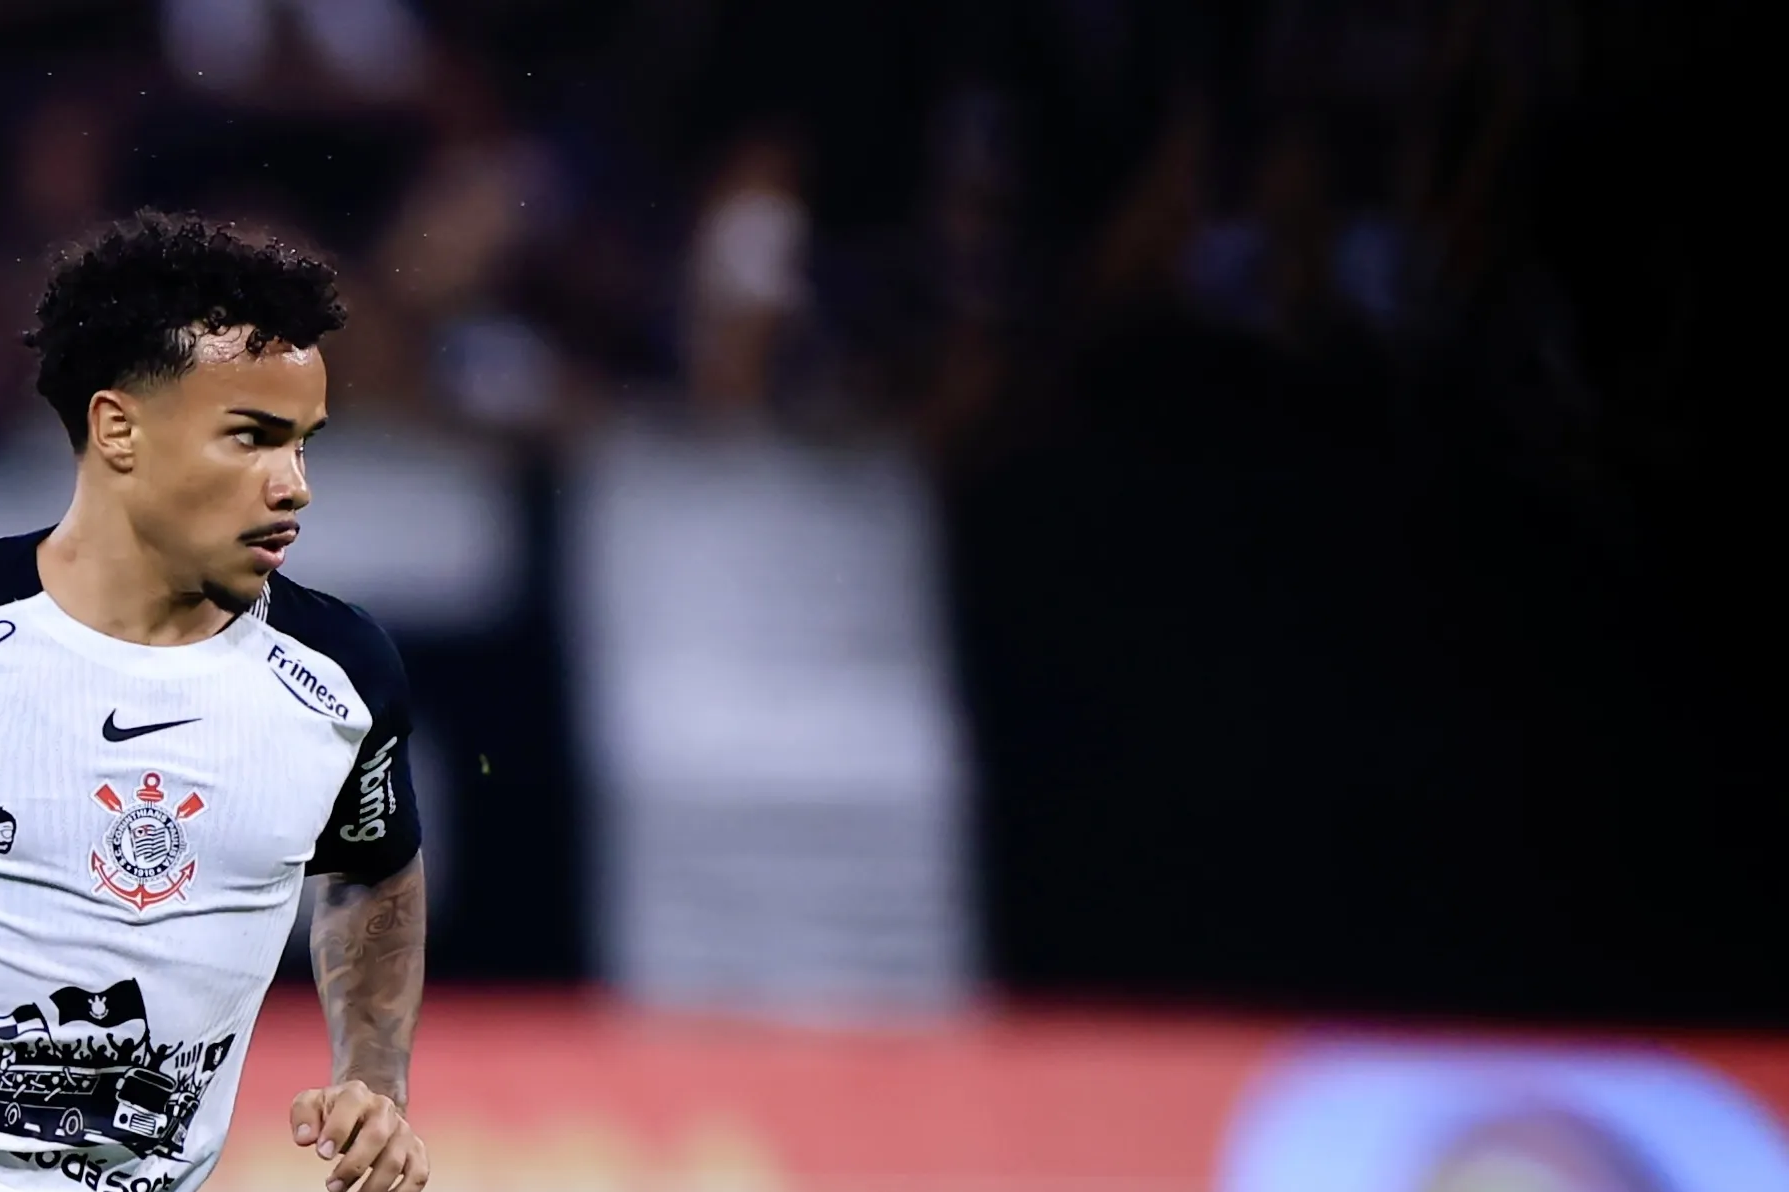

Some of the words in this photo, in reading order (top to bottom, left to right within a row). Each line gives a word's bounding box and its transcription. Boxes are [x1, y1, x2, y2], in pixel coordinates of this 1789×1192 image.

[267, 644, 350, 721] Frimesa
[113, 807, 168, 845] CORINTHIANS
[340, 756, 393, 842] bmg
